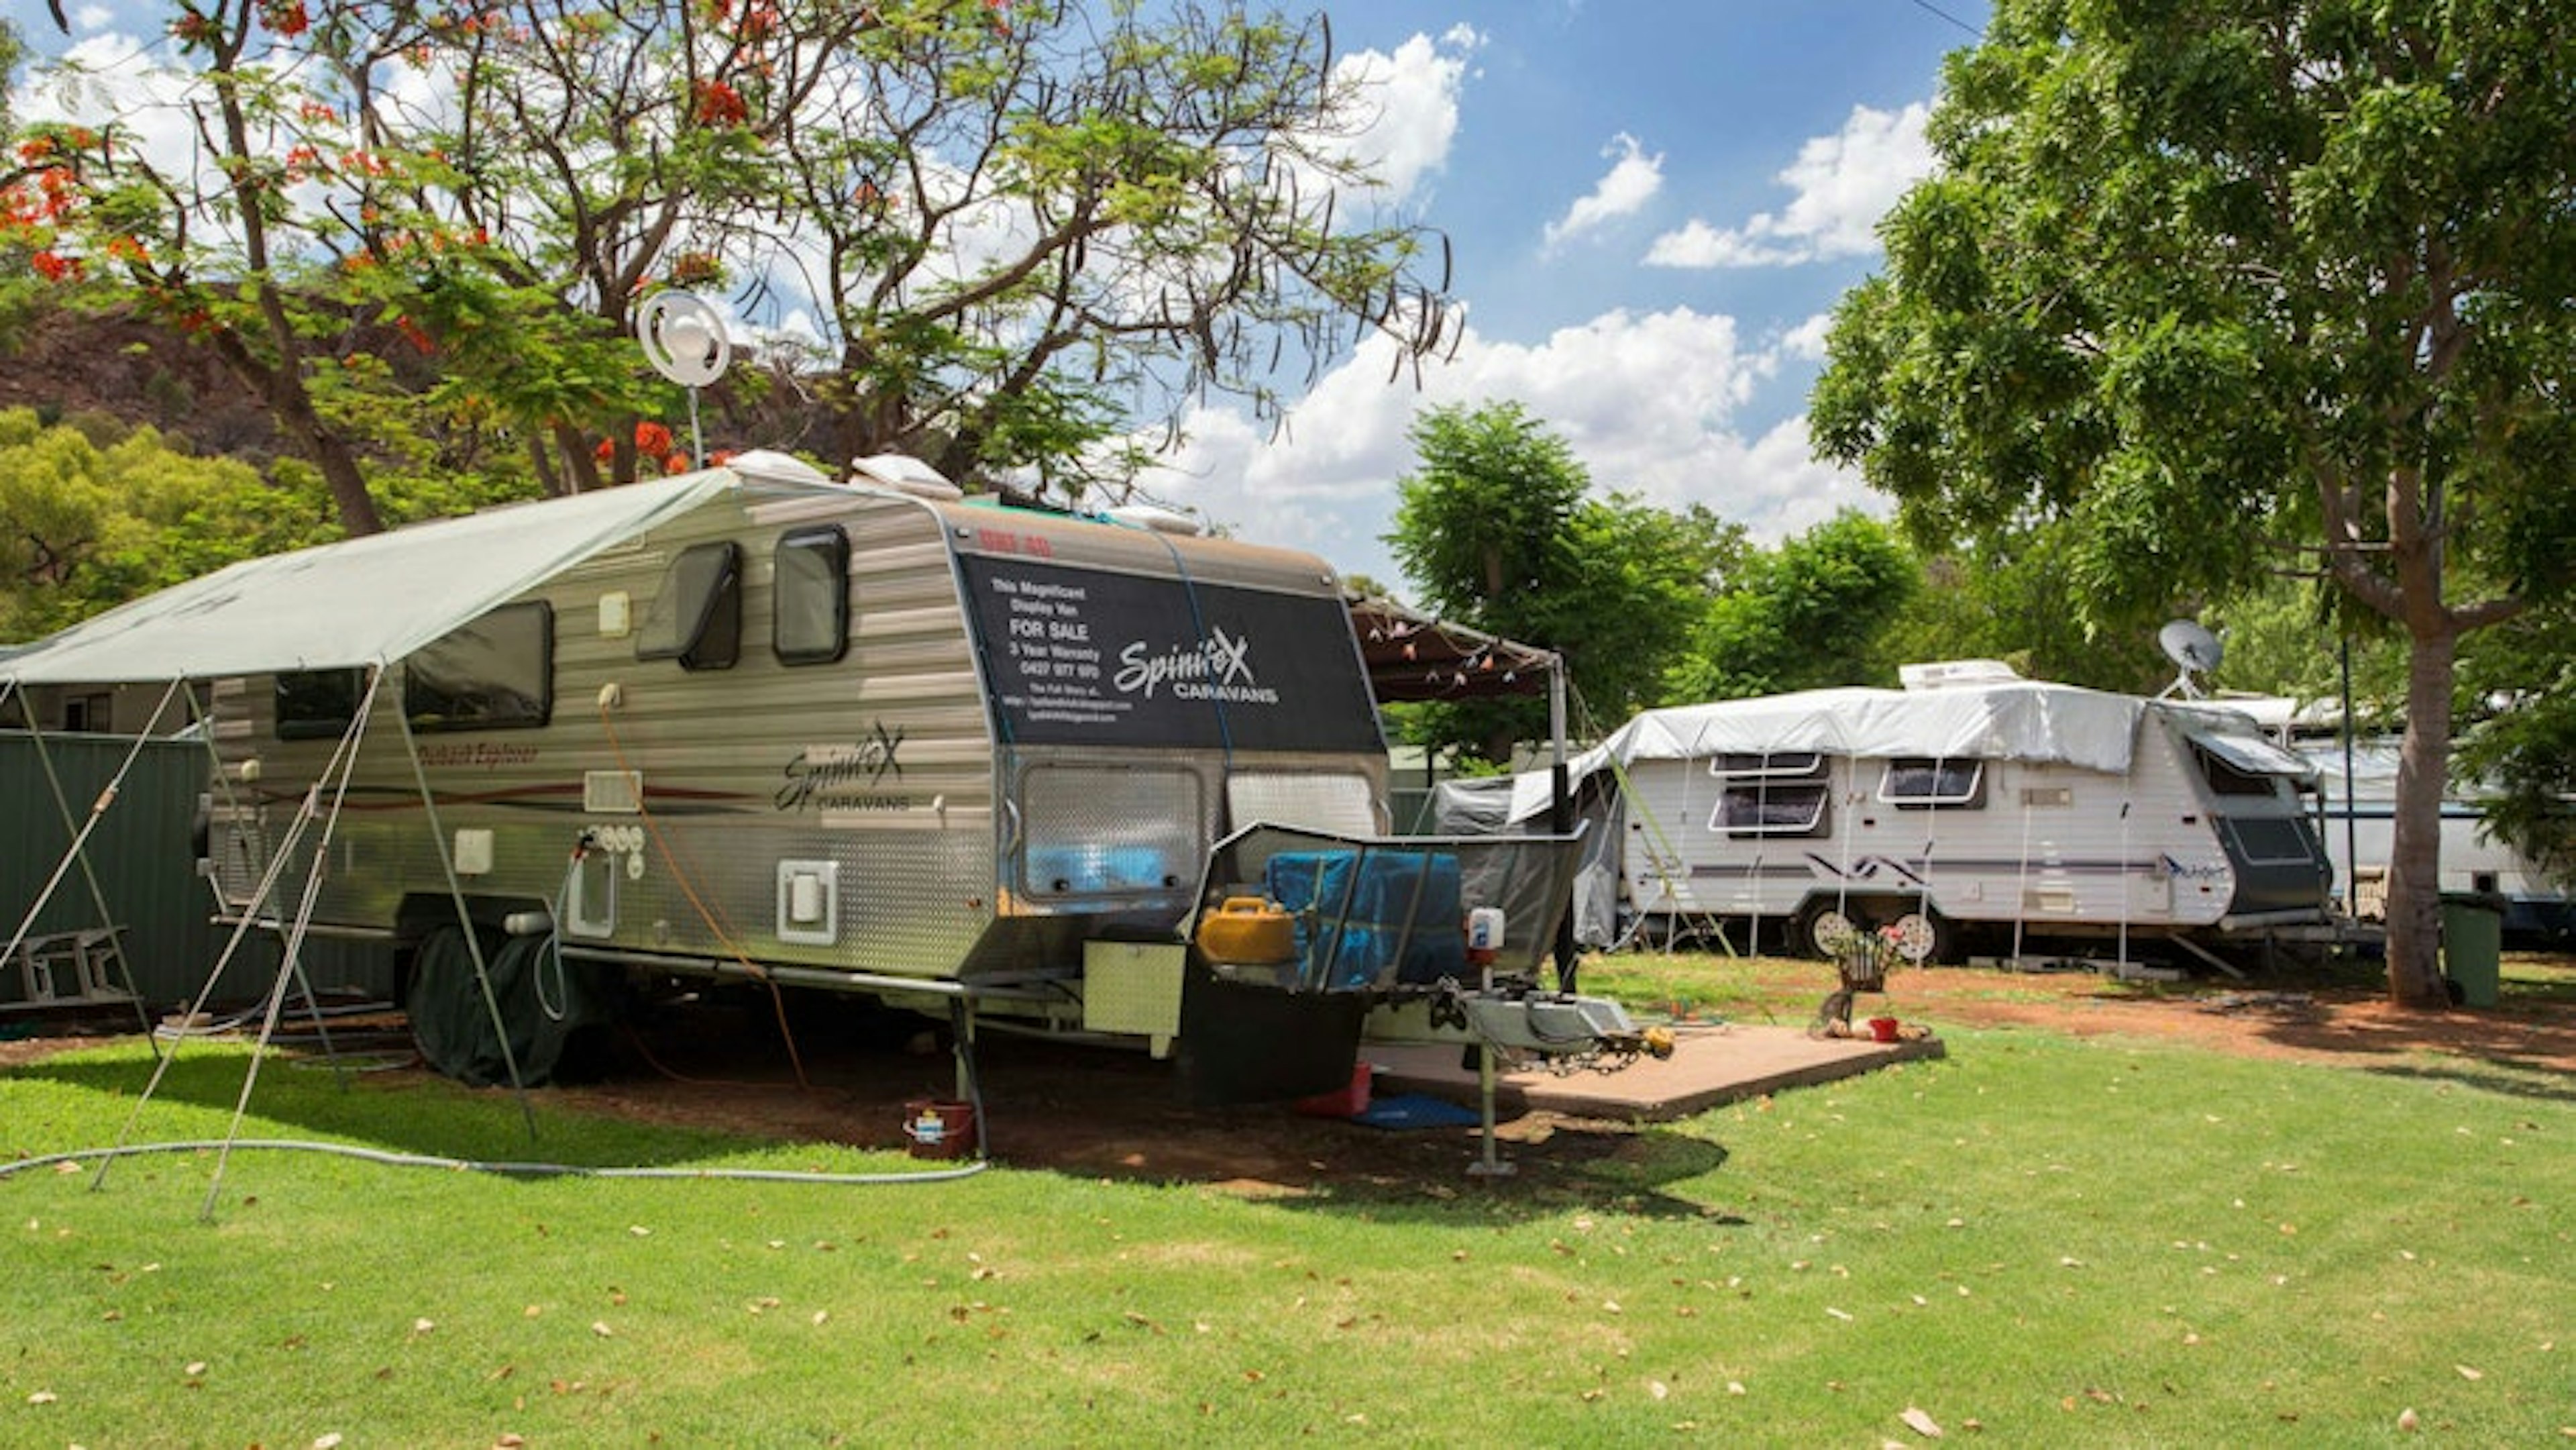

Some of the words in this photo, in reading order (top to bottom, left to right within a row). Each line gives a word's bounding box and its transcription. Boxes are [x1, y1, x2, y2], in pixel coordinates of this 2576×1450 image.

[991, 576, 1017, 593] This
[1020, 580, 1086, 600] Magnificent
[1010, 597, 1054, 616] Display
[1055, 601, 1078, 617] Van
[1009, 618, 1045, 637] FOR
[1049, 621, 1089, 641] SALE
[1009, 641, 1019, 656] 3
[1021, 642, 1049, 658] Year
[1049, 645, 1099, 663] Warranty
[1173, 681, 1279, 703] CARAVANS
[816, 795, 910, 812] CARAVANS
